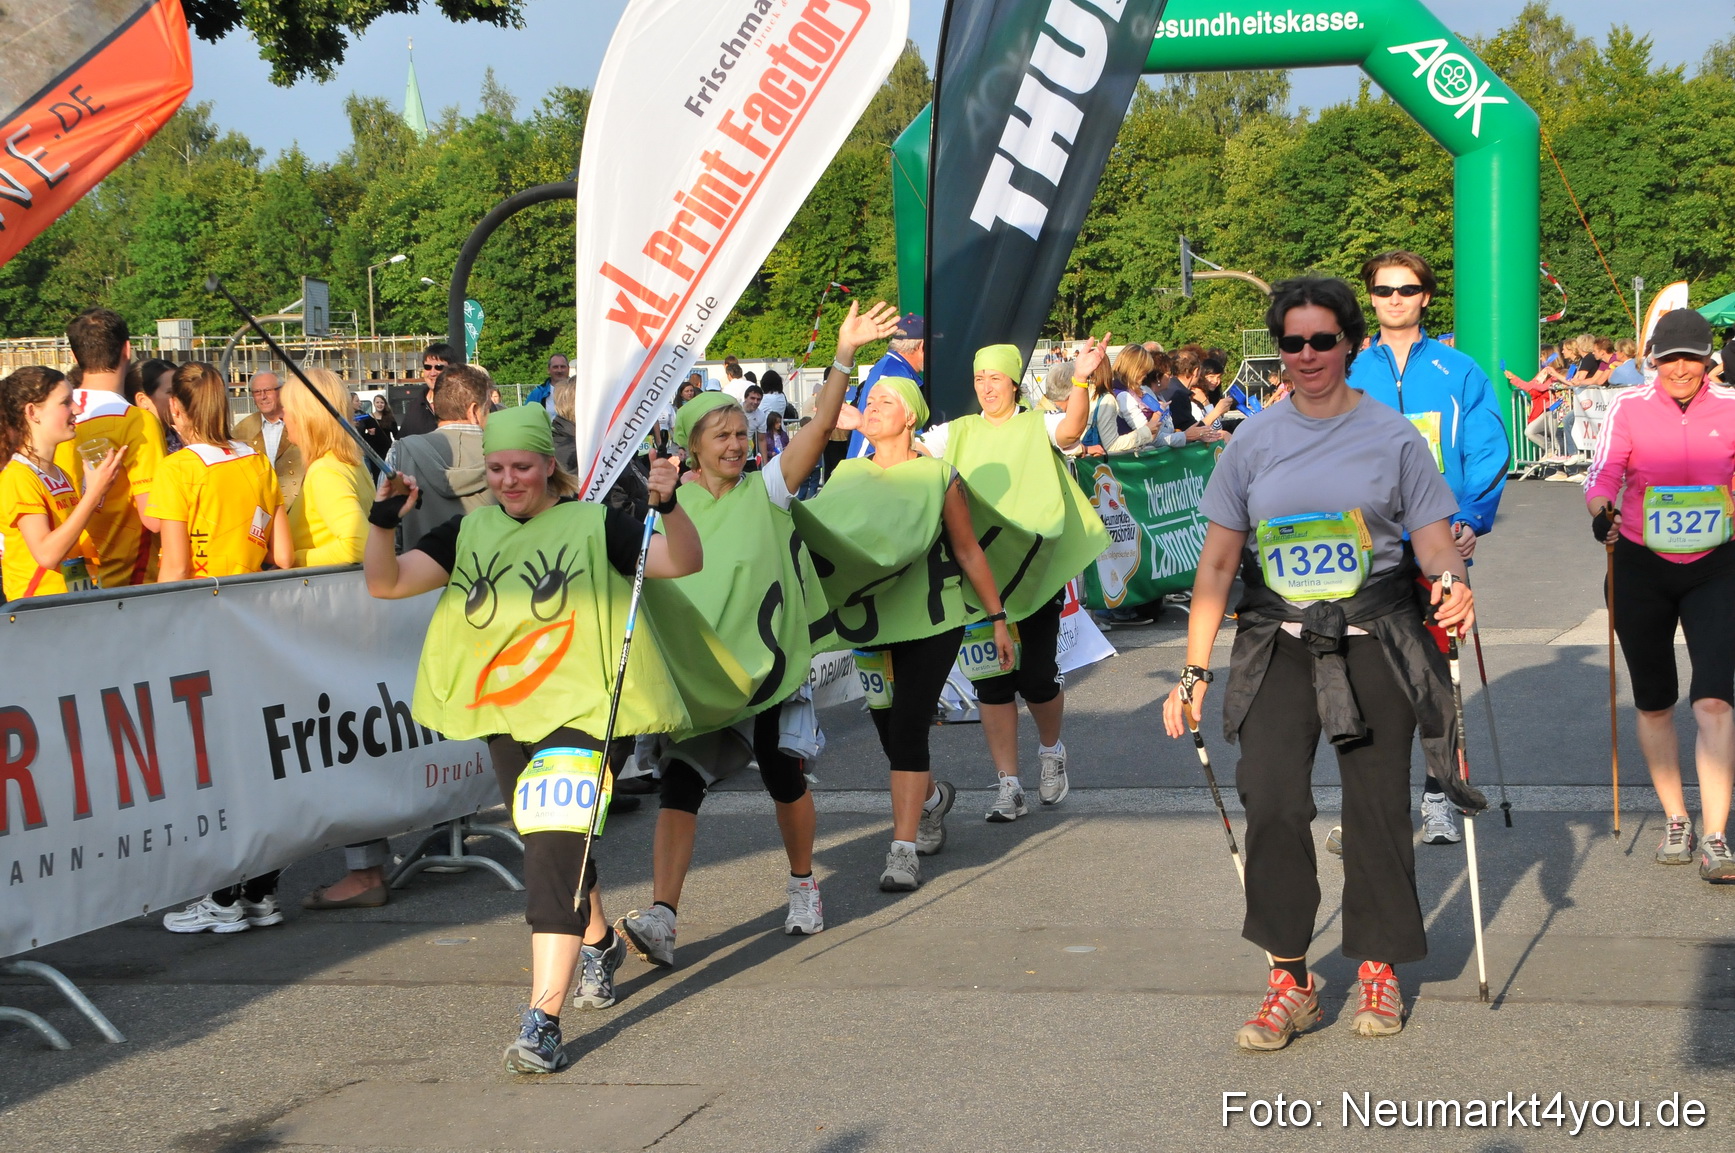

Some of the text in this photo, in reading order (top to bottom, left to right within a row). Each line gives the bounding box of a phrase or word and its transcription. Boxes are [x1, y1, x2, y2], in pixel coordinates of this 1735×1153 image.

[753, 12, 781, 48] Druck
[1154, 9, 1365, 39] esundheitskasse.
[684, 0, 775, 118] Frischma
[1386, 38, 1510, 139] AOK
[970, 0, 1128, 242] THU
[642, 149, 755, 283] Print
[1143, 467, 1205, 519] Neumarkter
[1648, 509, 1721, 534] 1327
[1267, 542, 1358, 578] 1328
[1288, 579, 1321, 588] Martina
[860, 671, 884, 694] 99
[425, 751, 485, 789] Druck
[518, 777, 596, 811] 1100
